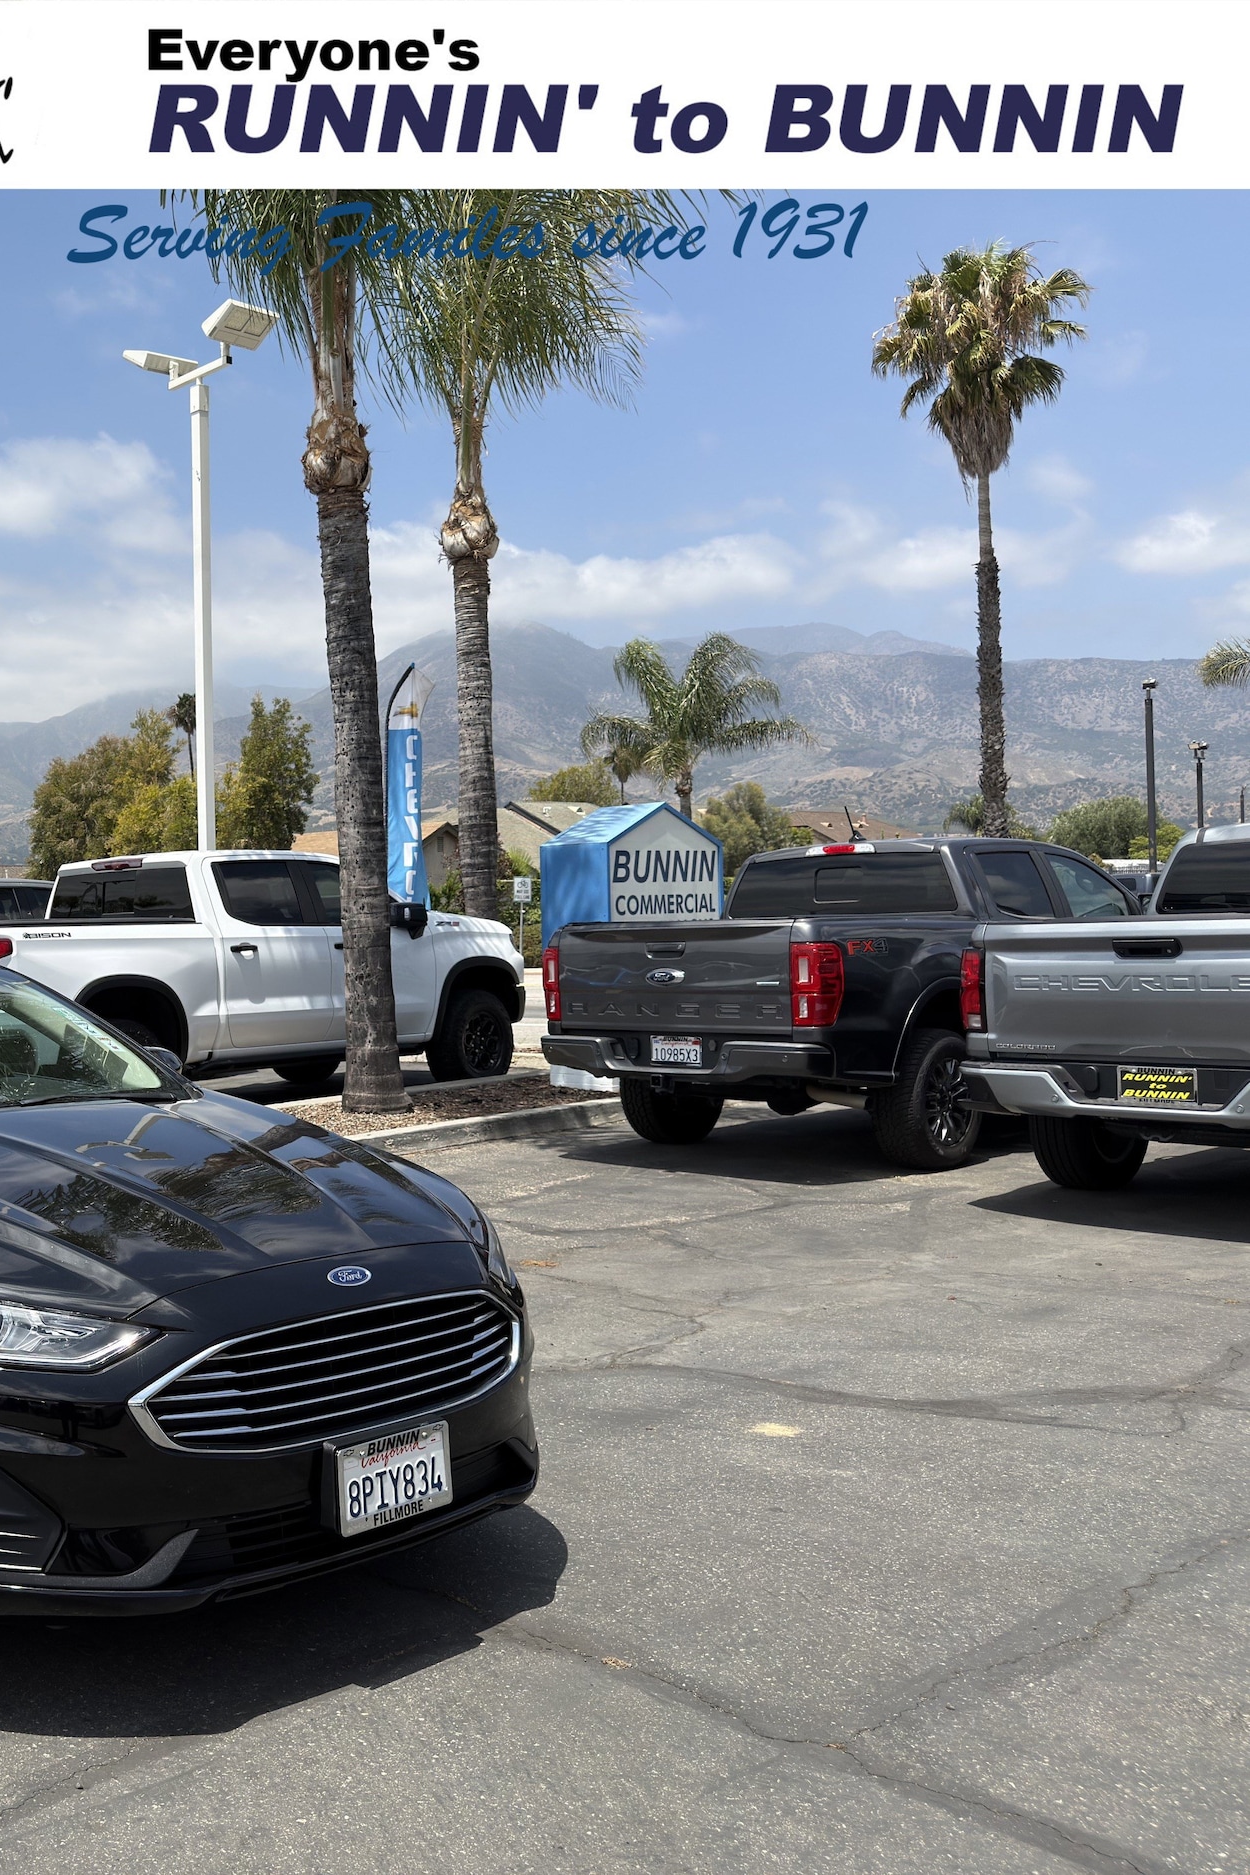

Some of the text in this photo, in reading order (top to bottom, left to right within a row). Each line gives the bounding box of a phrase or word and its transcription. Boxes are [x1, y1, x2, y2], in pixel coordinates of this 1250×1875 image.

[612, 850, 716, 883] BUNNIN
[615, 893, 716, 916] COMMERCIAL
[846, 938, 888, 956] FX4
[566, 1002, 783, 1019] RANGER
[654, 1047, 698, 1062] 10985X3
[1122, 1073, 1193, 1083] RUNNIN'
[1137, 1067, 1176, 1075] BUNNIN
[1122, 1089, 1190, 1100] BUNNIN
[338, 1270, 362, 1282] Ford
[367, 1429, 420, 1456] BUNNIN
[348, 1456, 443, 1518] 8PIY834
[373, 1499, 424, 1526] FILLMORE
